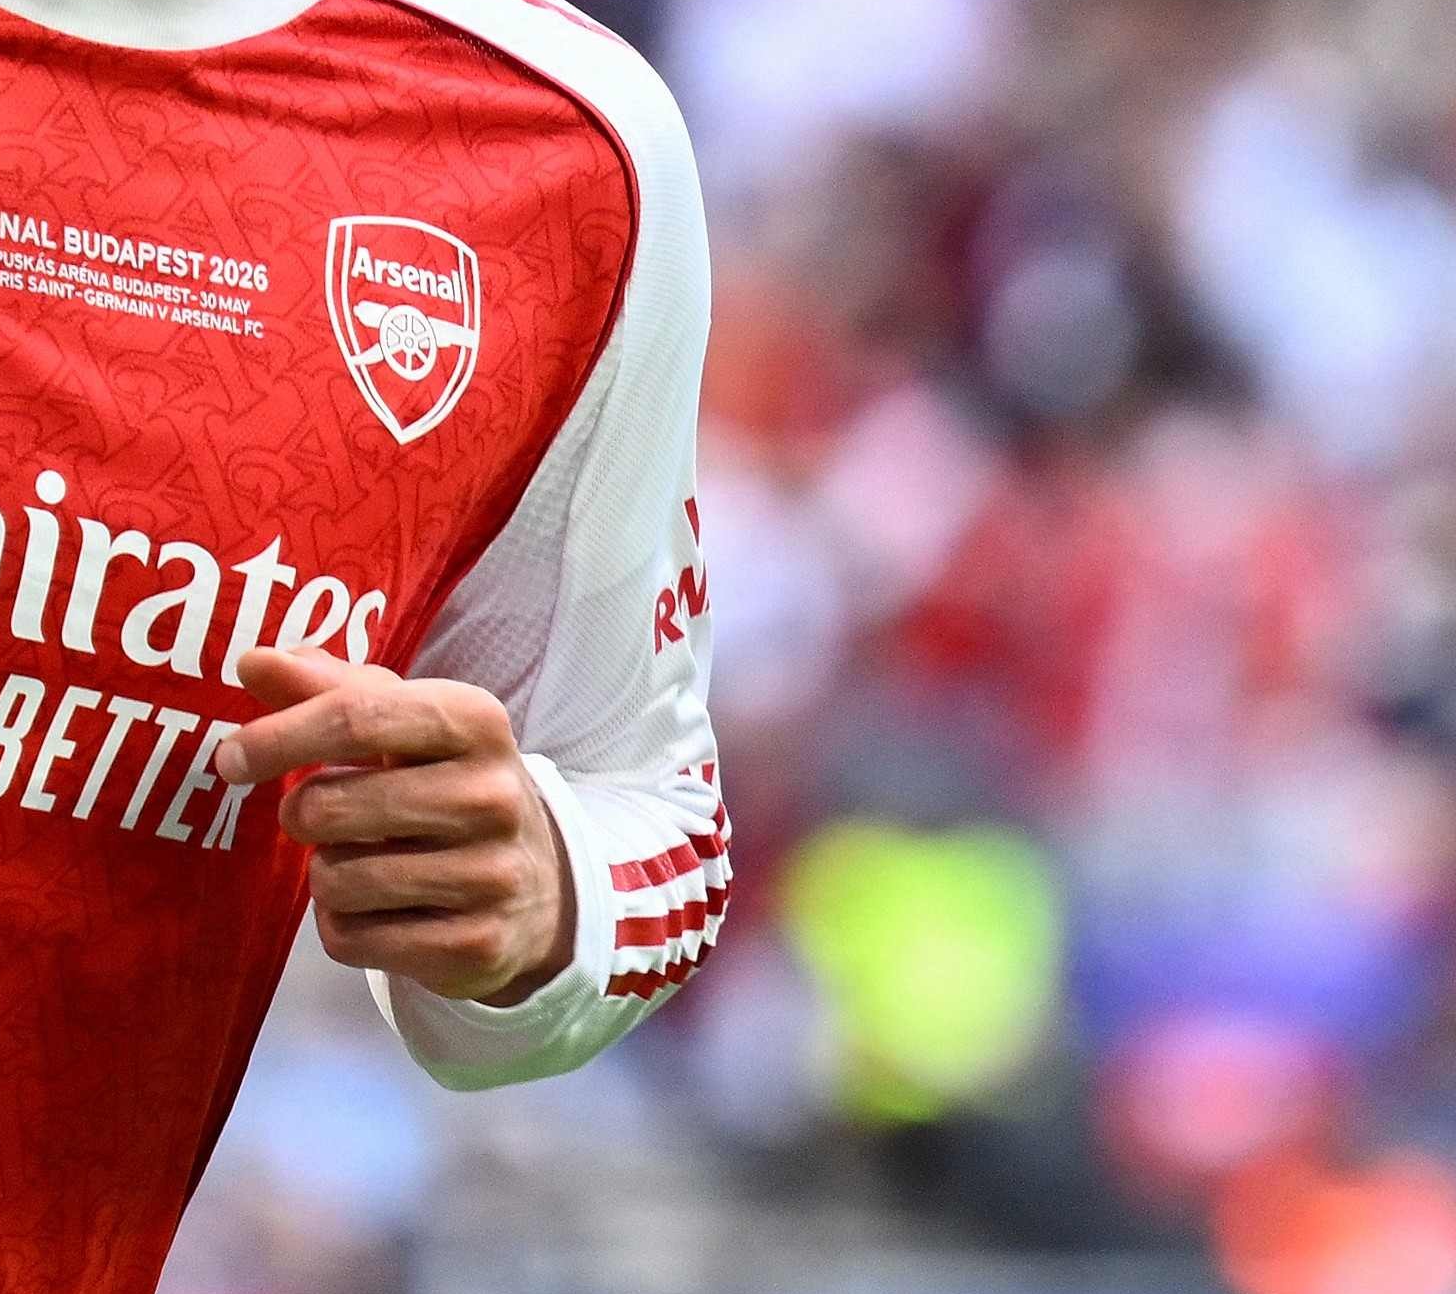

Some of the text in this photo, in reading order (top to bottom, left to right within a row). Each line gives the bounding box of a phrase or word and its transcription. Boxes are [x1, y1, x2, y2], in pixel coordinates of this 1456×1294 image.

[63, 225, 205, 280] BUDAPEST
[209, 255, 270, 292] 2026
[350, 246, 463, 304] Arsenal
[57, 260, 110, 290] ARÉNA
[218, 295, 251, 316] MAY
[156, 303, 169, 320] V
[170, 308, 242, 335] ARSENAL
[243, 319, 264, 339] FC
